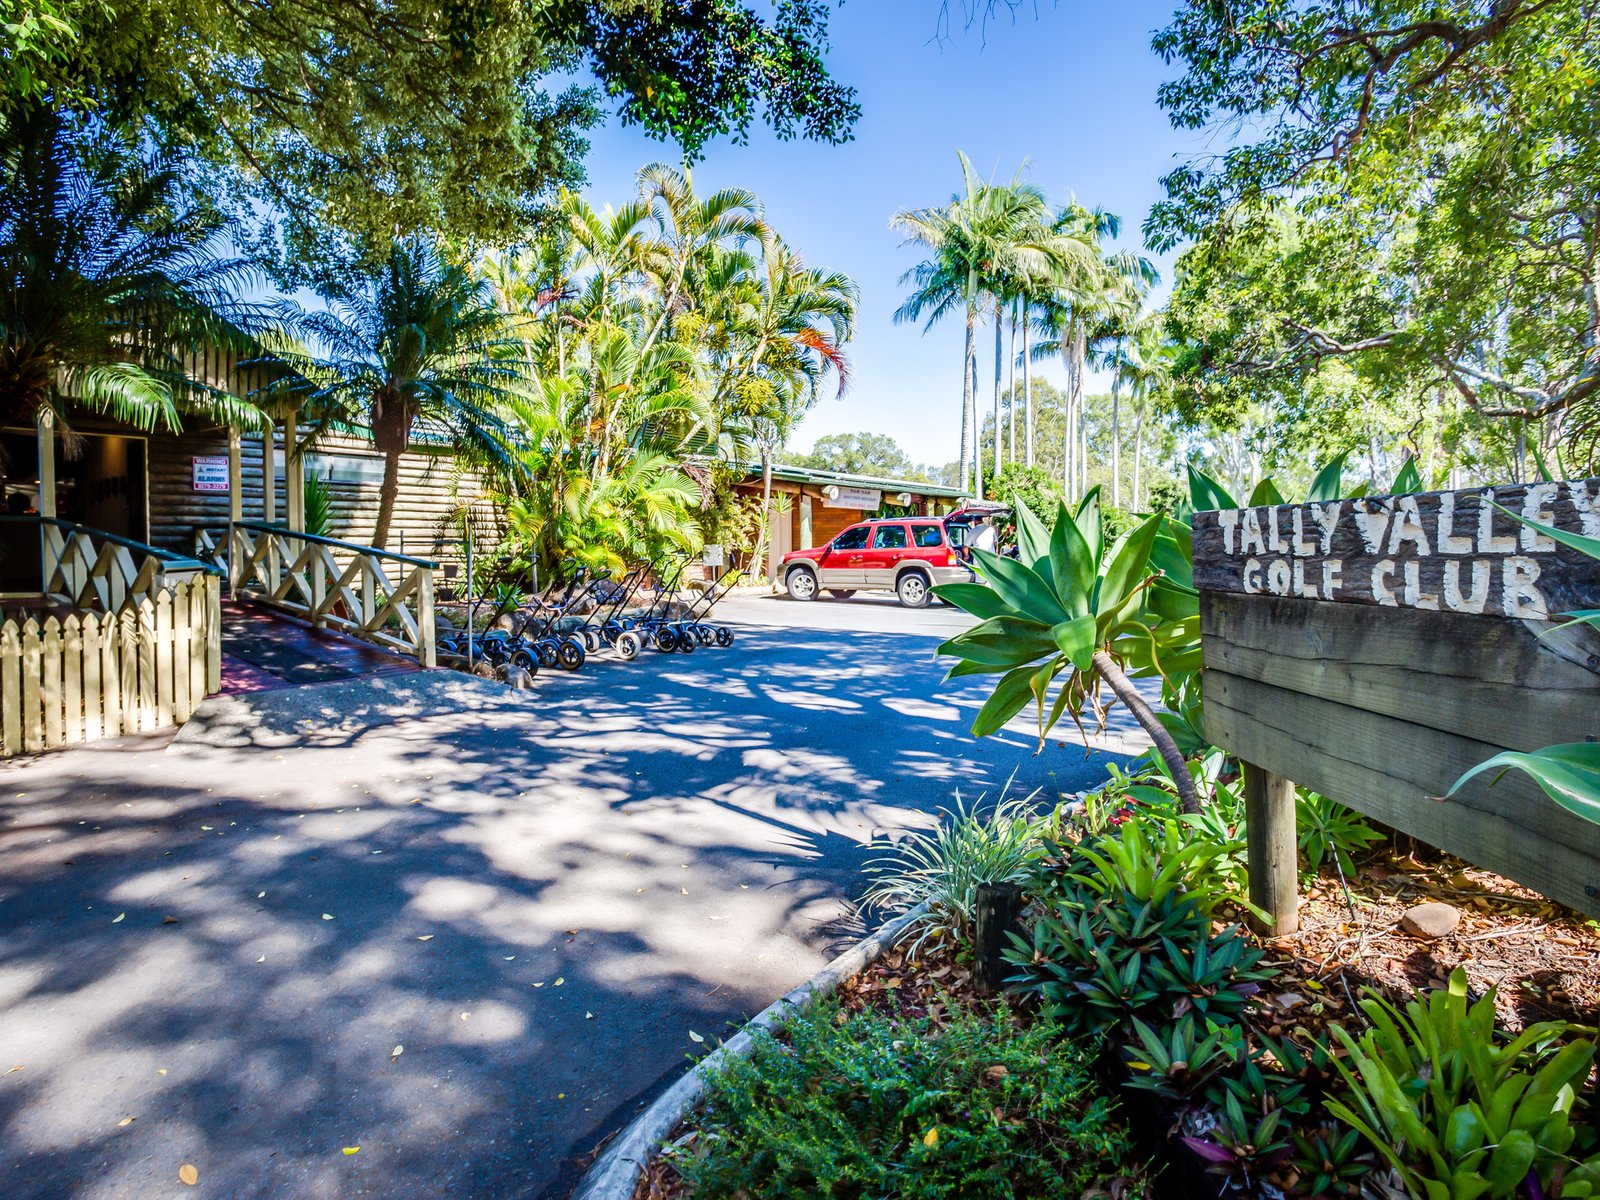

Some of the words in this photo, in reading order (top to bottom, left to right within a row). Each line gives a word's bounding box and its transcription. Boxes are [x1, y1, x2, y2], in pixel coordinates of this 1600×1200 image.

[196, 457, 226, 465] WARNING
[1218, 502, 1341, 555] TALLY
[1244, 558, 1342, 599] GOLF
[1372, 556, 1548, 620] CLUB
